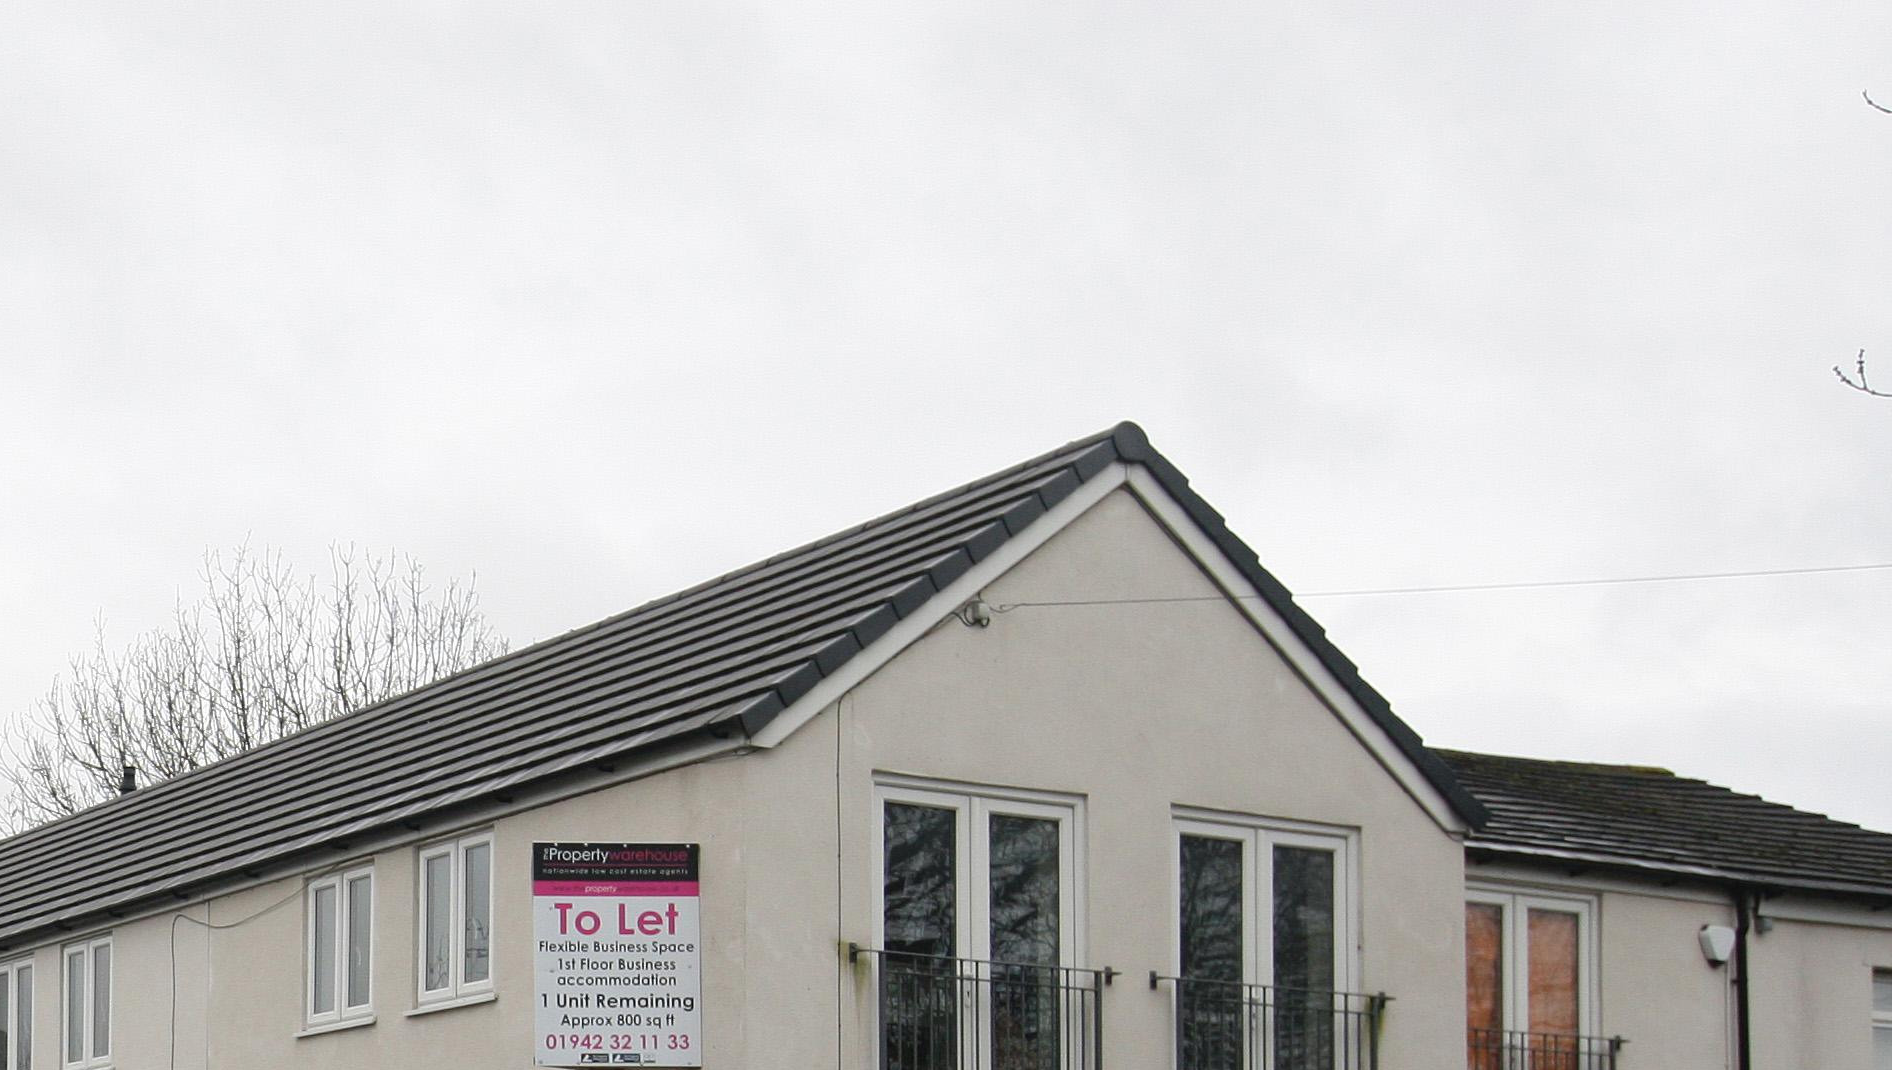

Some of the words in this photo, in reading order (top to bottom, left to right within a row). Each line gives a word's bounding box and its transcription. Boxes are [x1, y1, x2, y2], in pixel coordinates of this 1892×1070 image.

[630, 867, 657, 876] estate
[660, 867, 689, 877] agents
[554, 903, 601, 936] To
[618, 903, 679, 936] Let
[539, 941, 589, 953] Flexible
[593, 941, 648, 953] Business
[652, 941, 695, 955] Space
[558, 958, 576, 970] 1st
[580, 958, 614, 970] Floor
[618, 958, 677, 970] Business
[557, 974, 677, 986] accommodation
[541, 993, 548, 1008] 1
[557, 993, 590, 1008] Unit
[596, 993, 695, 1012] Remaining
[561, 1014, 612, 1029] Approx
[617, 1014, 642, 1026] 800
[646, 1016, 662, 1029] sq
[666, 1014, 675, 1026] ft
[546, 1034, 603, 1050] 01942
[609, 1034, 633, 1050] 32
[640, 1034, 658, 1050] 11
[667, 1034, 690, 1050] 33
